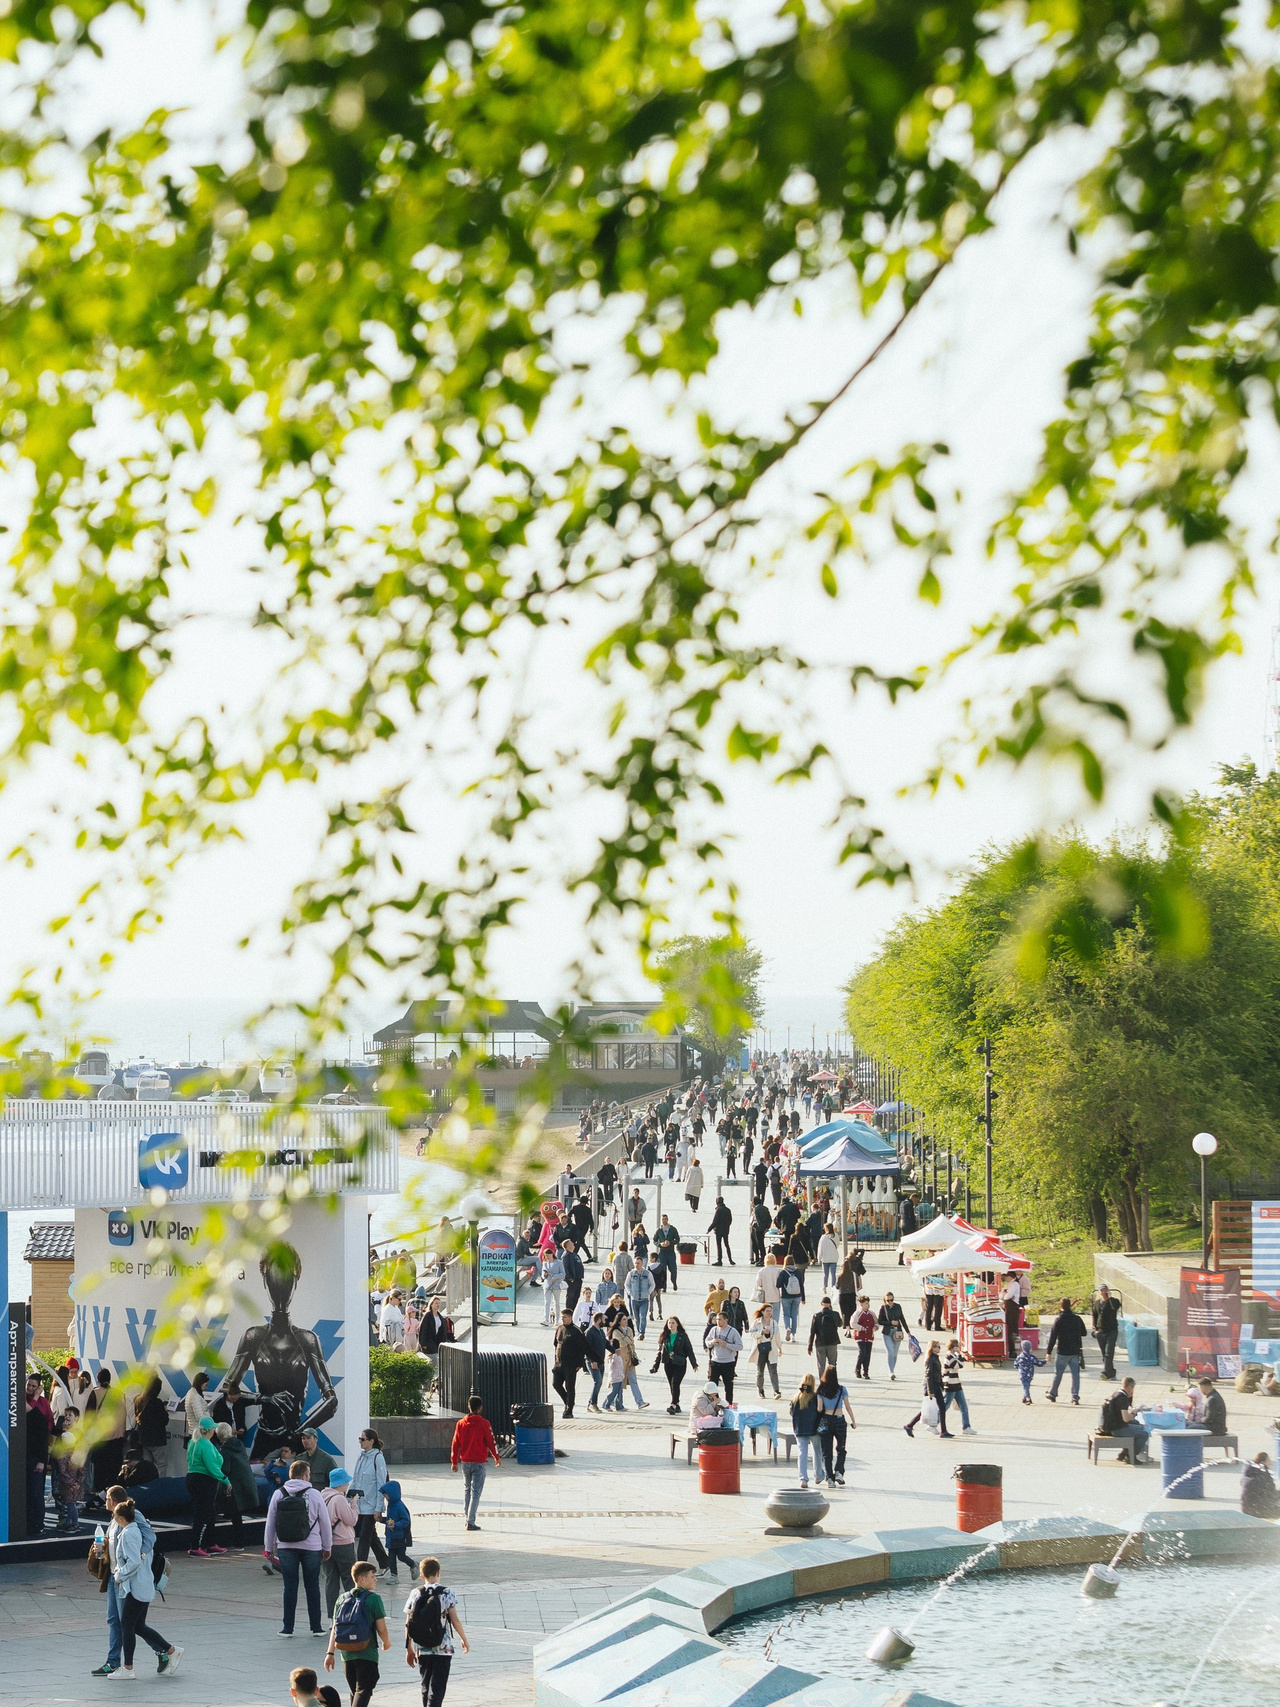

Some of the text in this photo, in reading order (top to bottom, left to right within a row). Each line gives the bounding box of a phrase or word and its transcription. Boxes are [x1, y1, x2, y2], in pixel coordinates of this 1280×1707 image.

[153, 1150, 183, 1175] VK
[140, 1219, 200, 1246] VK Play
[481, 1252, 513, 1260] ПРОКАТ
[109, 1261, 134, 1274] все
[137, 1262, 177, 1279] грани
[8, 1320, 19, 1428] Арт-практикум
